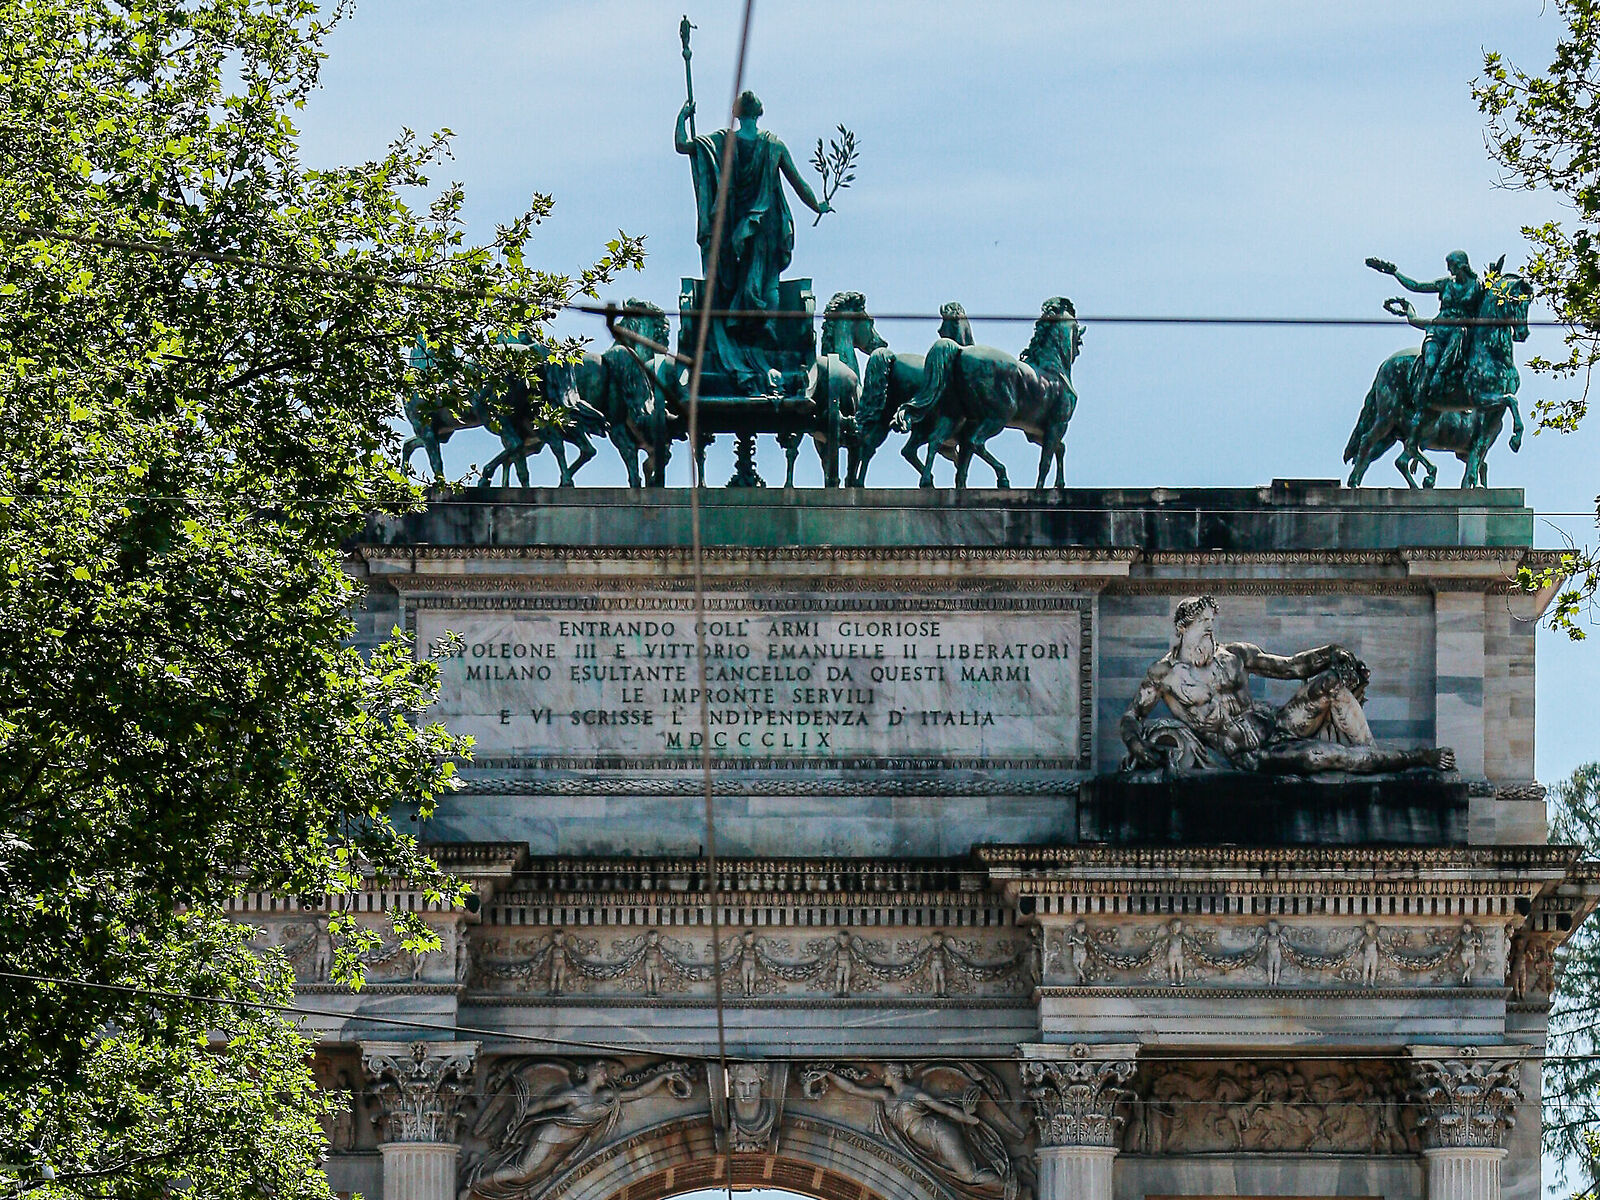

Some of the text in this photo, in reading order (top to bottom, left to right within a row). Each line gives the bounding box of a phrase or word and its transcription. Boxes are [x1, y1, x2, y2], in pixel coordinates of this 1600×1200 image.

[559, 621, 675, 637] ENTRANDO
[767, 621, 819, 637] ARMI
[838, 621, 941, 637] GLORIOSE
[575, 643, 597, 659] III
[615, 643, 626, 659] E
[645, 643, 750, 659] VITTORIO
[768, 643, 885, 660] EMANUELE
[903, 643, 918, 659] II
[936, 643, 1070, 660] LIBERATORI
[466, 665, 552, 681] MILANO
[570, 665, 686, 683] ESULTANTE
[826, 666, 854, 682] DA
[870, 666, 945, 683] QUESTI
[960, 666, 1031, 682] MARMI
[621, 688, 875, 704] LE IMPRONTE SERVILI
[499, 709, 511, 725] E
[531, 709, 552, 725] VI
[570, 709, 653, 726] SCRISSE
[708, 709, 869, 726] NDIPENDENZA
[921, 710, 995, 726] ITALIA
